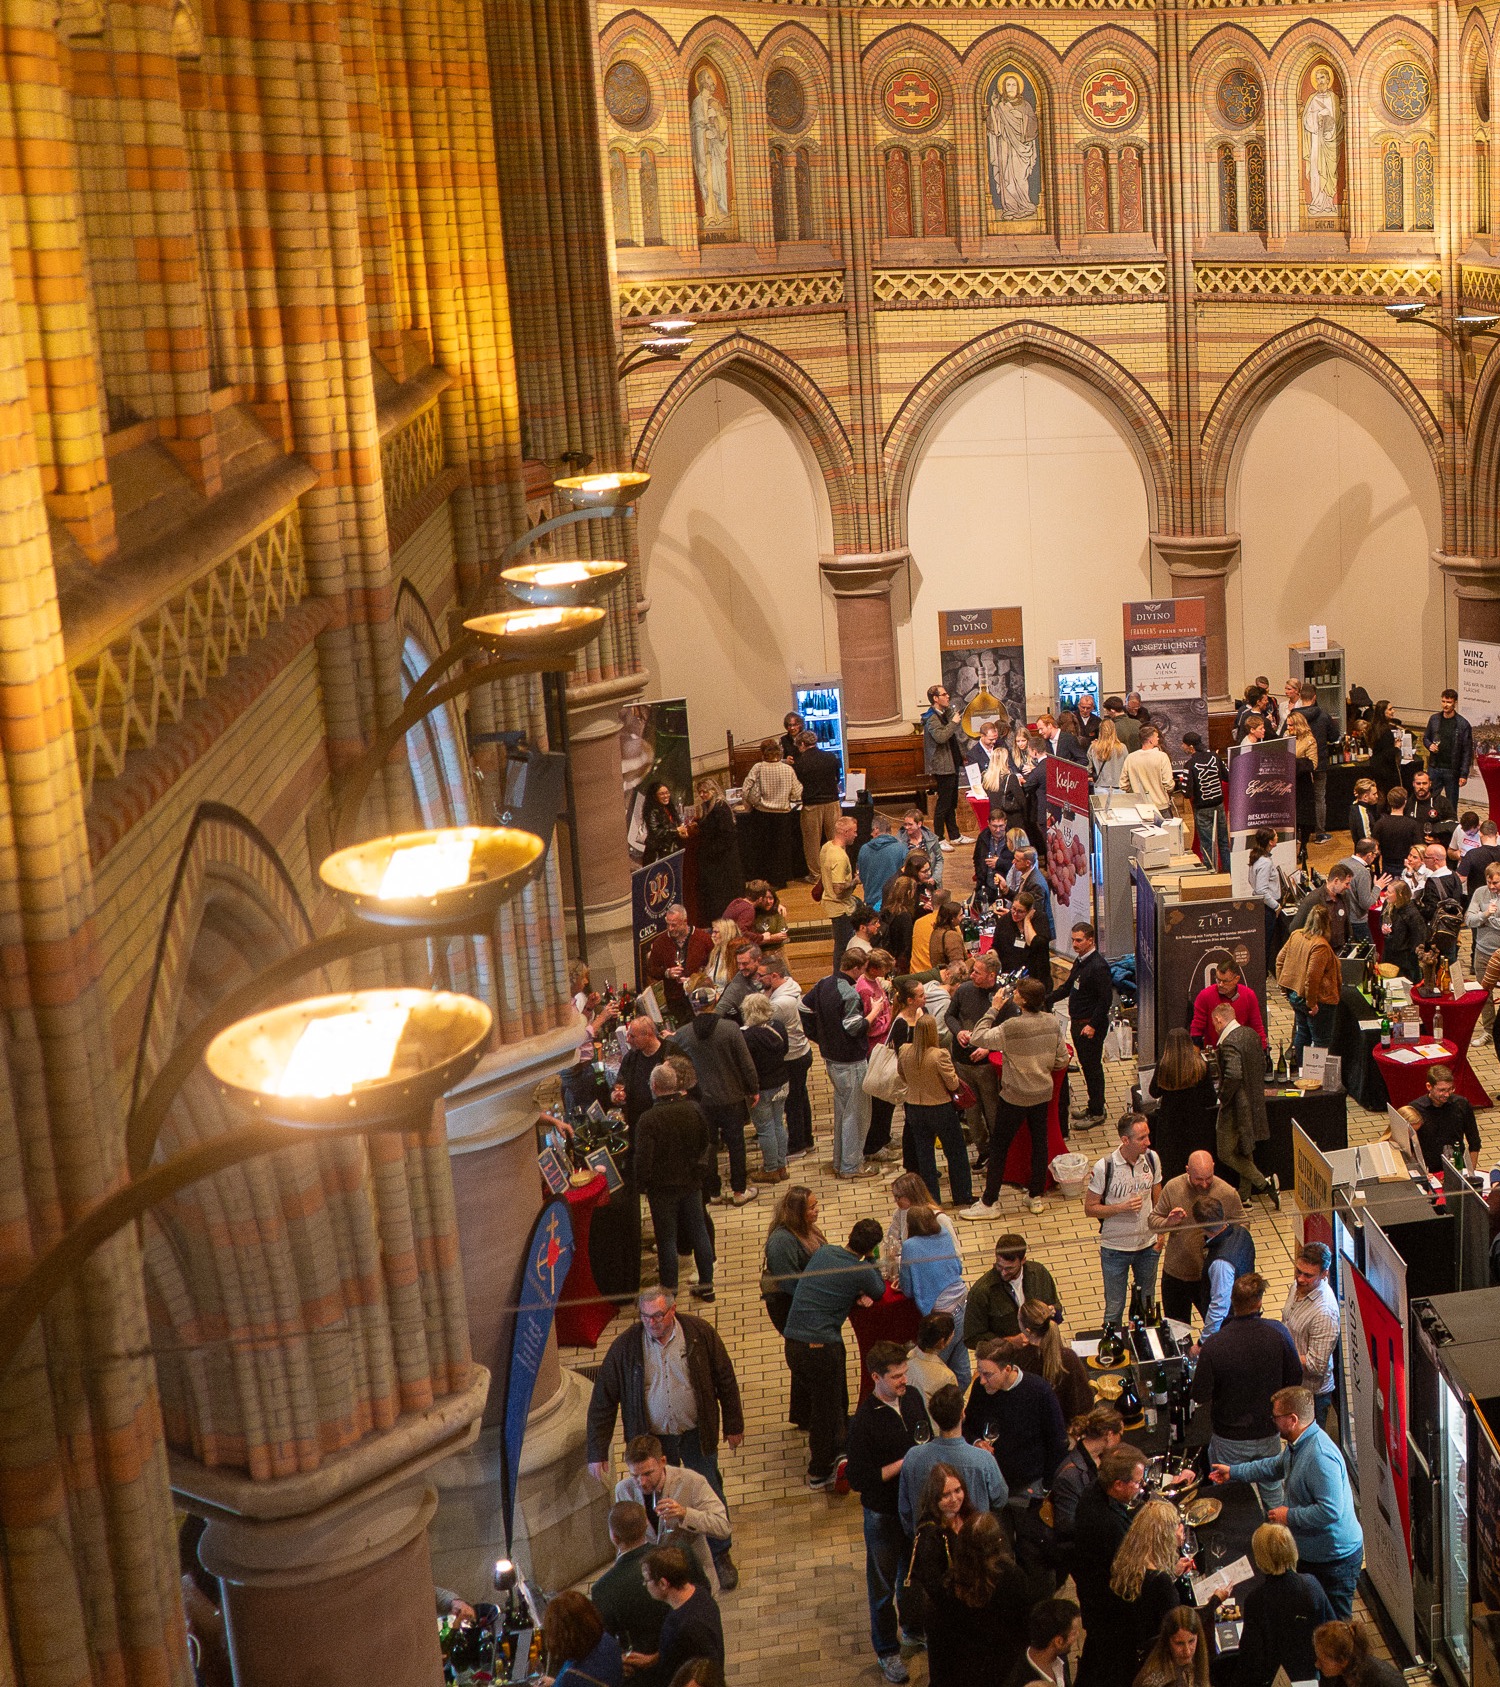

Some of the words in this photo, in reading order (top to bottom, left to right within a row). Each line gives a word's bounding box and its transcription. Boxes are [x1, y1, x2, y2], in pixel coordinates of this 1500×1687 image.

[1136, 613, 1170, 621] DIVINO
[953, 623, 988, 632] DIVINO
[1131, 641, 1199, 652] AUSGEZEICHNET
[1463, 649, 1484, 659] WINZ
[1155, 661, 1177, 670] AWC
[1463, 658, 1489, 668] ERHOF
[1247, 813, 1270, 821] RIESLING
[1198, 916, 1233, 928] ZIPF
